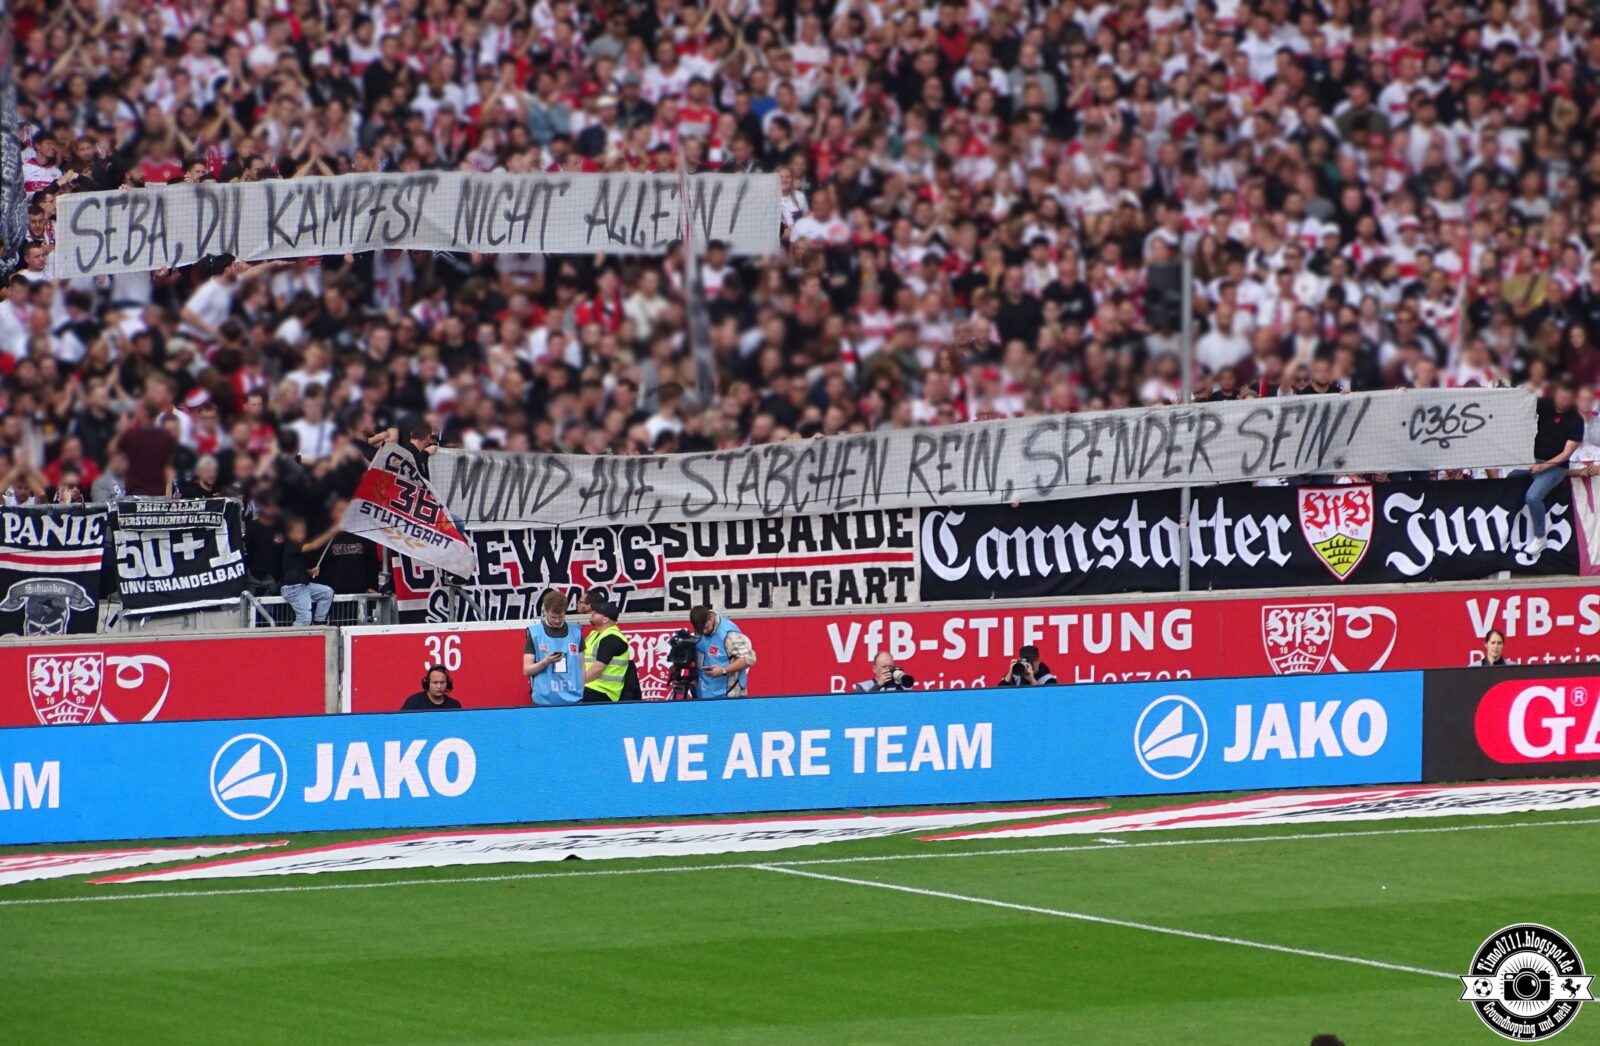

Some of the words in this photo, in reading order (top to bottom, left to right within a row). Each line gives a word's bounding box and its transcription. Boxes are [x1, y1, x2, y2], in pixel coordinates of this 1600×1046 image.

[71, 194, 184, 274] SEBA,
[194, 184, 241, 256] DU
[264, 174, 439, 250] KÄMPFST
[451, 177, 571, 250] NICHT
[446, 454, 573, 525] MUND
[578, 456, 668, 523] AUF,
[906, 424, 1014, 504] REIN,
[1022, 411, 1222, 496] SPENDER
[1237, 396, 1372, 475] SEIN!
[169, 500, 207, 512] ALLEN
[359, 501, 454, 549] STUTTGART
[390, 478, 440, 524] 36
[113, 518, 243, 579] 50+1
[921, 496, 1293, 582] Cannstatter
[1382, 491, 1573, 577] Jungs
[120, 562, 246, 595] UNVERHANDELBAR
[668, 566, 915, 612] STUTTGART
[424, 634, 462, 672] 36
[826, 608, 1193, 664] VfB-STIFTUNG
[623, 734, 709, 783] WE
[722, 728, 831, 780] ARE
[844, 721, 993, 774] TEAM
[1224, 698, 1388, 762] JAKO
[304, 737, 477, 803] JAKO
